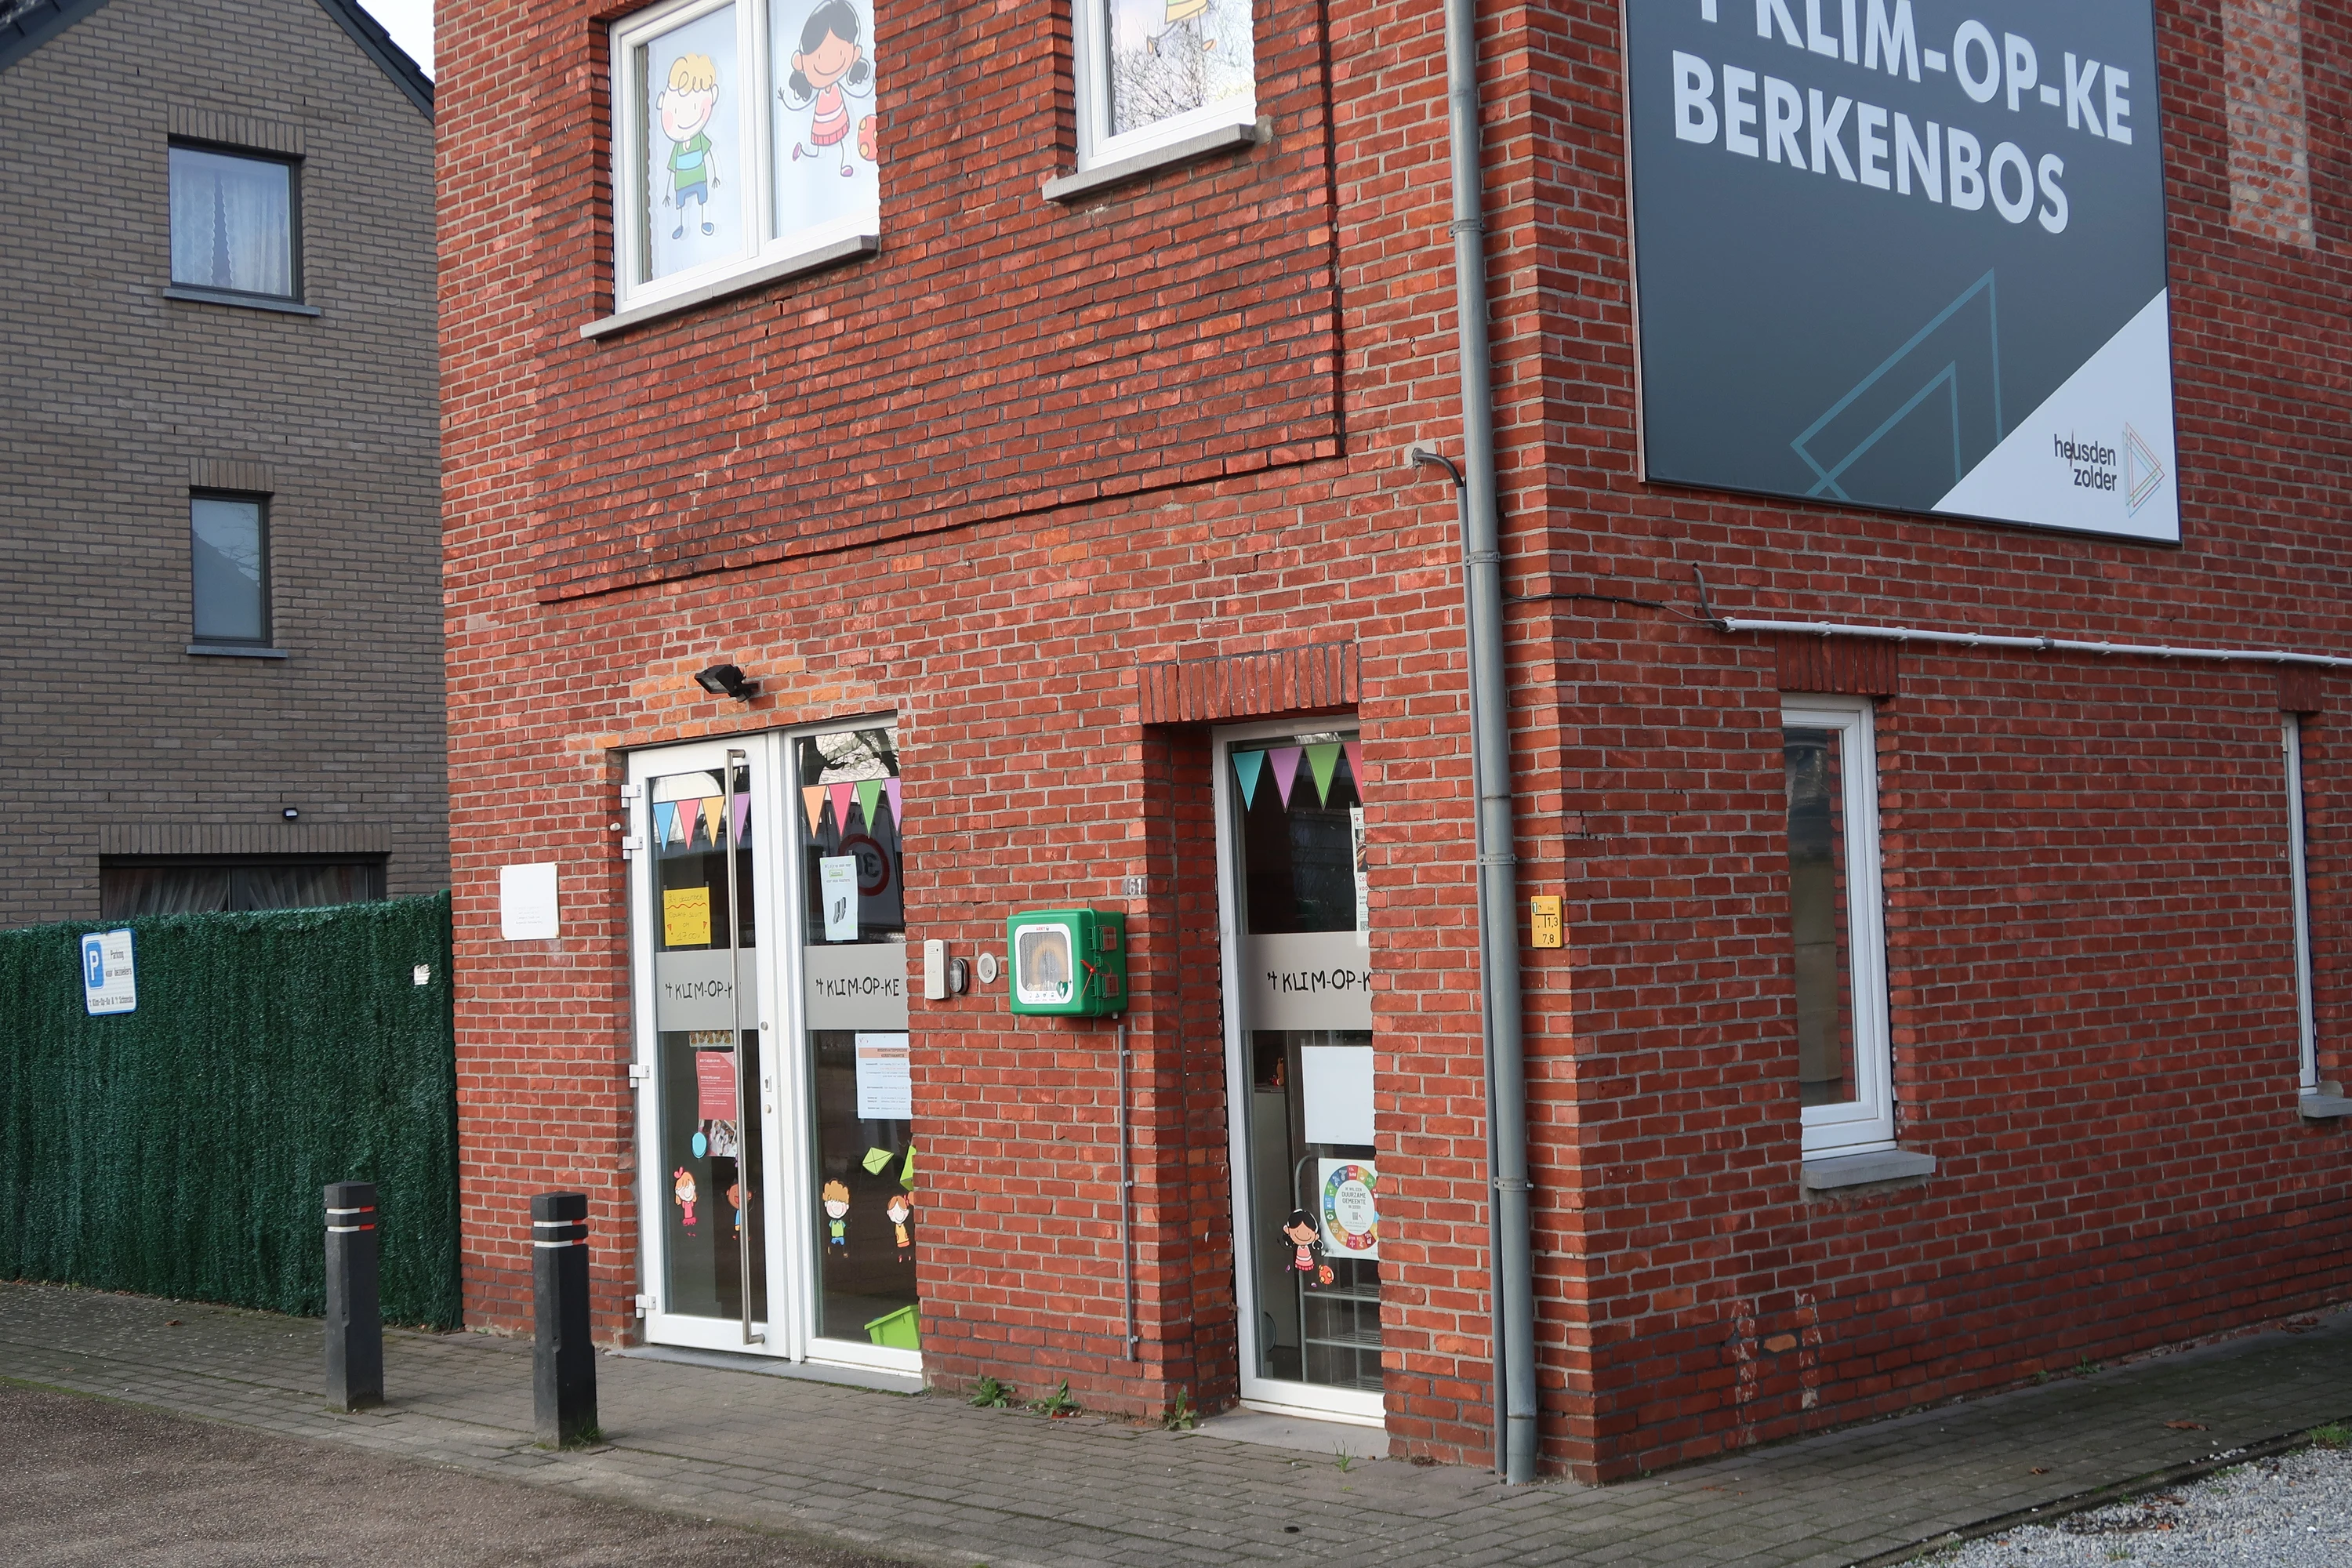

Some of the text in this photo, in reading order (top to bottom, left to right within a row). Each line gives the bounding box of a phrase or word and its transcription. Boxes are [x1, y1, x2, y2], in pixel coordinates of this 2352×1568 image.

[1672, 49, 2069, 234] BERKENBOS
[2053, 431, 2117, 466] heusden
[2074, 465, 2118, 492] zolder
[1542, 933, 1555, 945] 7,8
[89, 950, 100, 981] P
[111, 949, 125, 960] Parking
[675, 980, 735, 1000] KLIM-OP-K
[827, 976, 899, 997] KLIM-OP-KE
[1283, 968, 1370, 993] KLIM-OP-K
